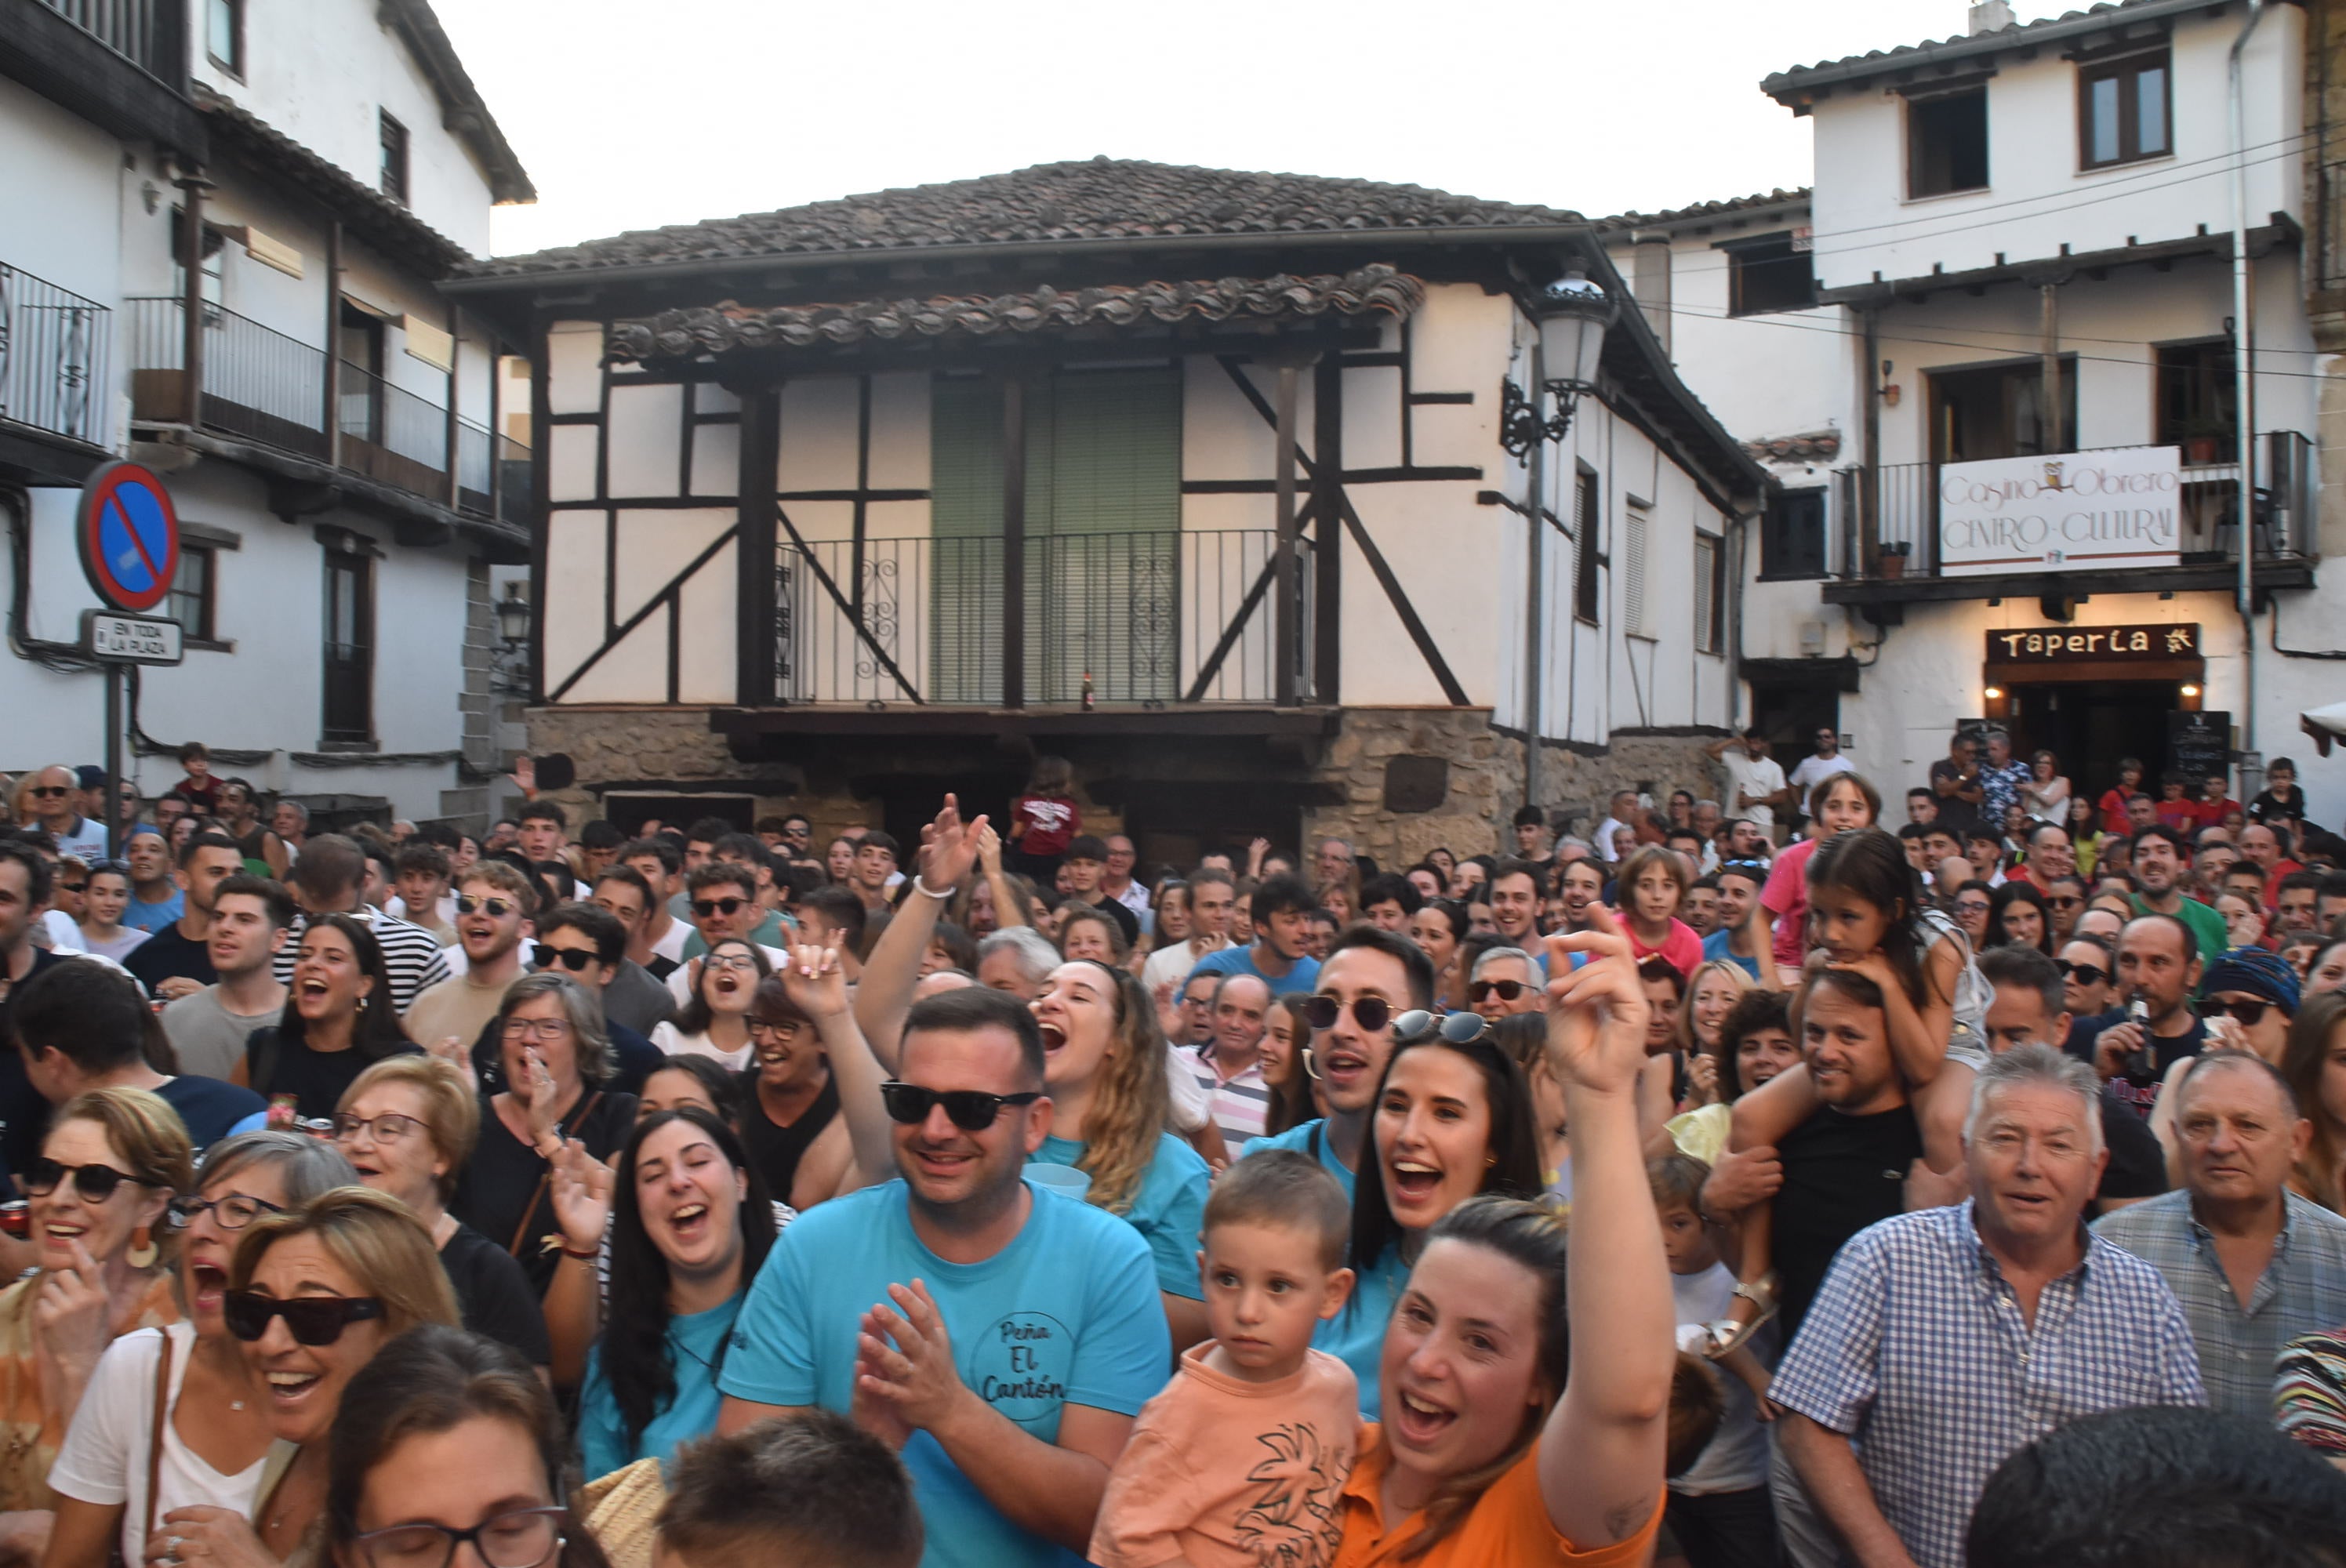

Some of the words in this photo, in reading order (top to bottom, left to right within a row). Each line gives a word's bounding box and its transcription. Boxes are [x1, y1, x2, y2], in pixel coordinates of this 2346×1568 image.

[1941, 475, 2040, 512] Casino
[2072, 468, 2180, 496] Obrero
[1943, 514, 2050, 553] CENTRO
[2061, 508, 2177, 546] CULTURAL
[114, 621, 130, 637] EN
[133, 624, 164, 640] TODA
[110, 637, 126, 652] LA
[129, 639, 168, 655] PLAZA
[999, 1321, 1052, 1343] Peña
[1008, 1345, 1039, 1374] El
[982, 1374, 1066, 1403] Cantón
